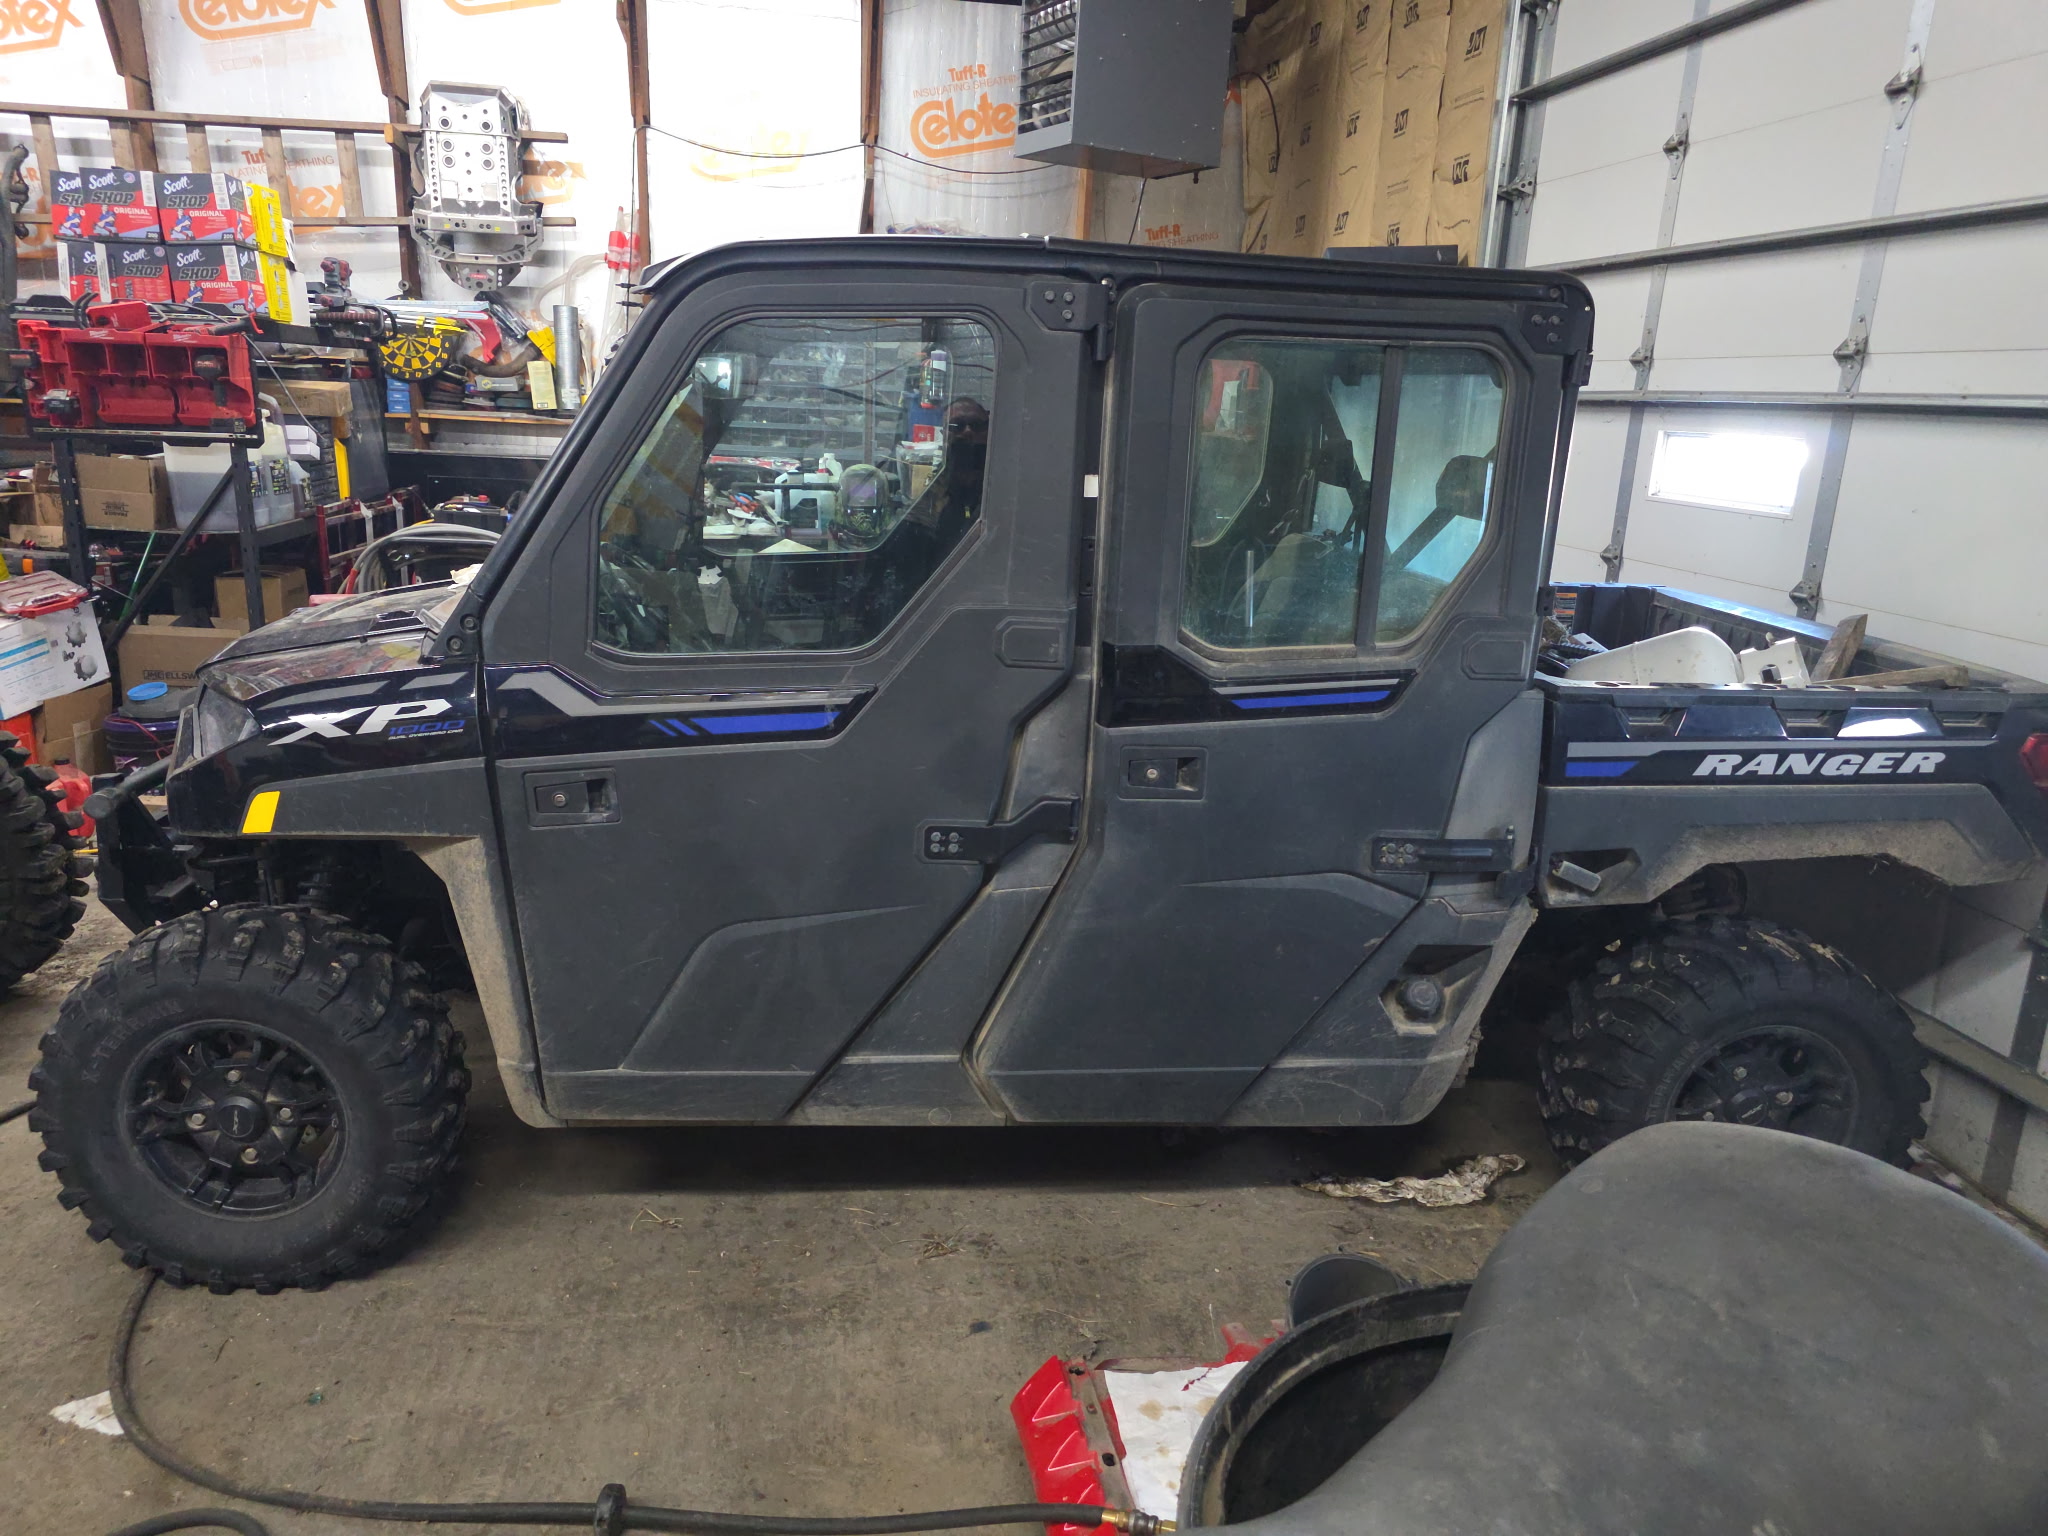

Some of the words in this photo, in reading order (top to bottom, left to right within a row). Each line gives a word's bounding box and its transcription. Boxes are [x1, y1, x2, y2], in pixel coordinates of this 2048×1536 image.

[948, 64, 987, 82] Tuff-R
[913, 82, 971, 98] INSULATING
[910, 91, 1017, 157] Celote
[88, 172, 116, 189] Scott
[163, 175, 189, 194] Scott
[91, 190, 135, 205] SHOP
[167, 195, 208, 208] SHOP
[114, 207, 150, 215] ORIGINAL
[123, 248, 147, 264] Scott
[176, 248, 202, 267] Scott
[124, 265, 163, 278] SHOP
[179, 266, 220, 280] SHOP
[165, 671, 200, 680] ELLSW
[267, 699, 452, 746] XP
[389, 720, 466, 736] 1000
[1692, 752, 1946, 776] RANGER
